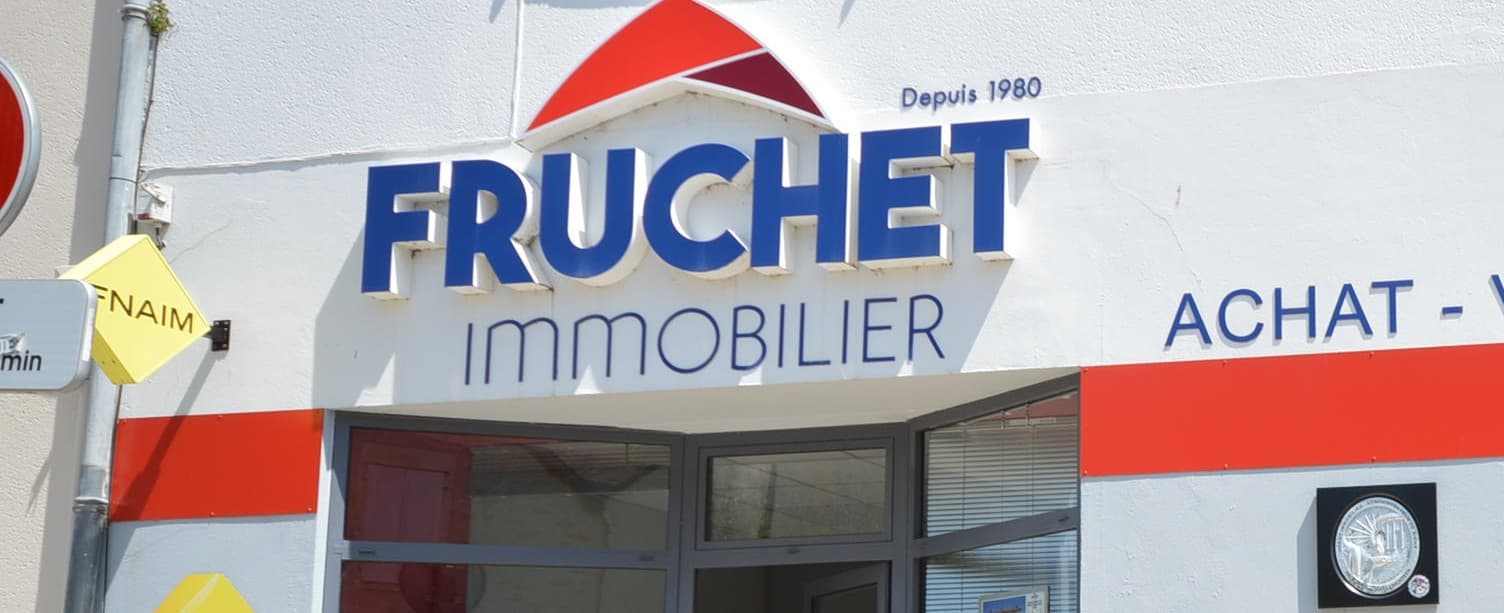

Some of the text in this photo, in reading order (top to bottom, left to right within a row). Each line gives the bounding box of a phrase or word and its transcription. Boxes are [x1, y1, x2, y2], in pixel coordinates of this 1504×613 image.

[902, 76, 1042, 111] Depuis 1980
[361, 118, 1031, 294] FRUCHET
[1167, 280, 1416, 347] ACHAT
[0, 350, 42, 371] min
